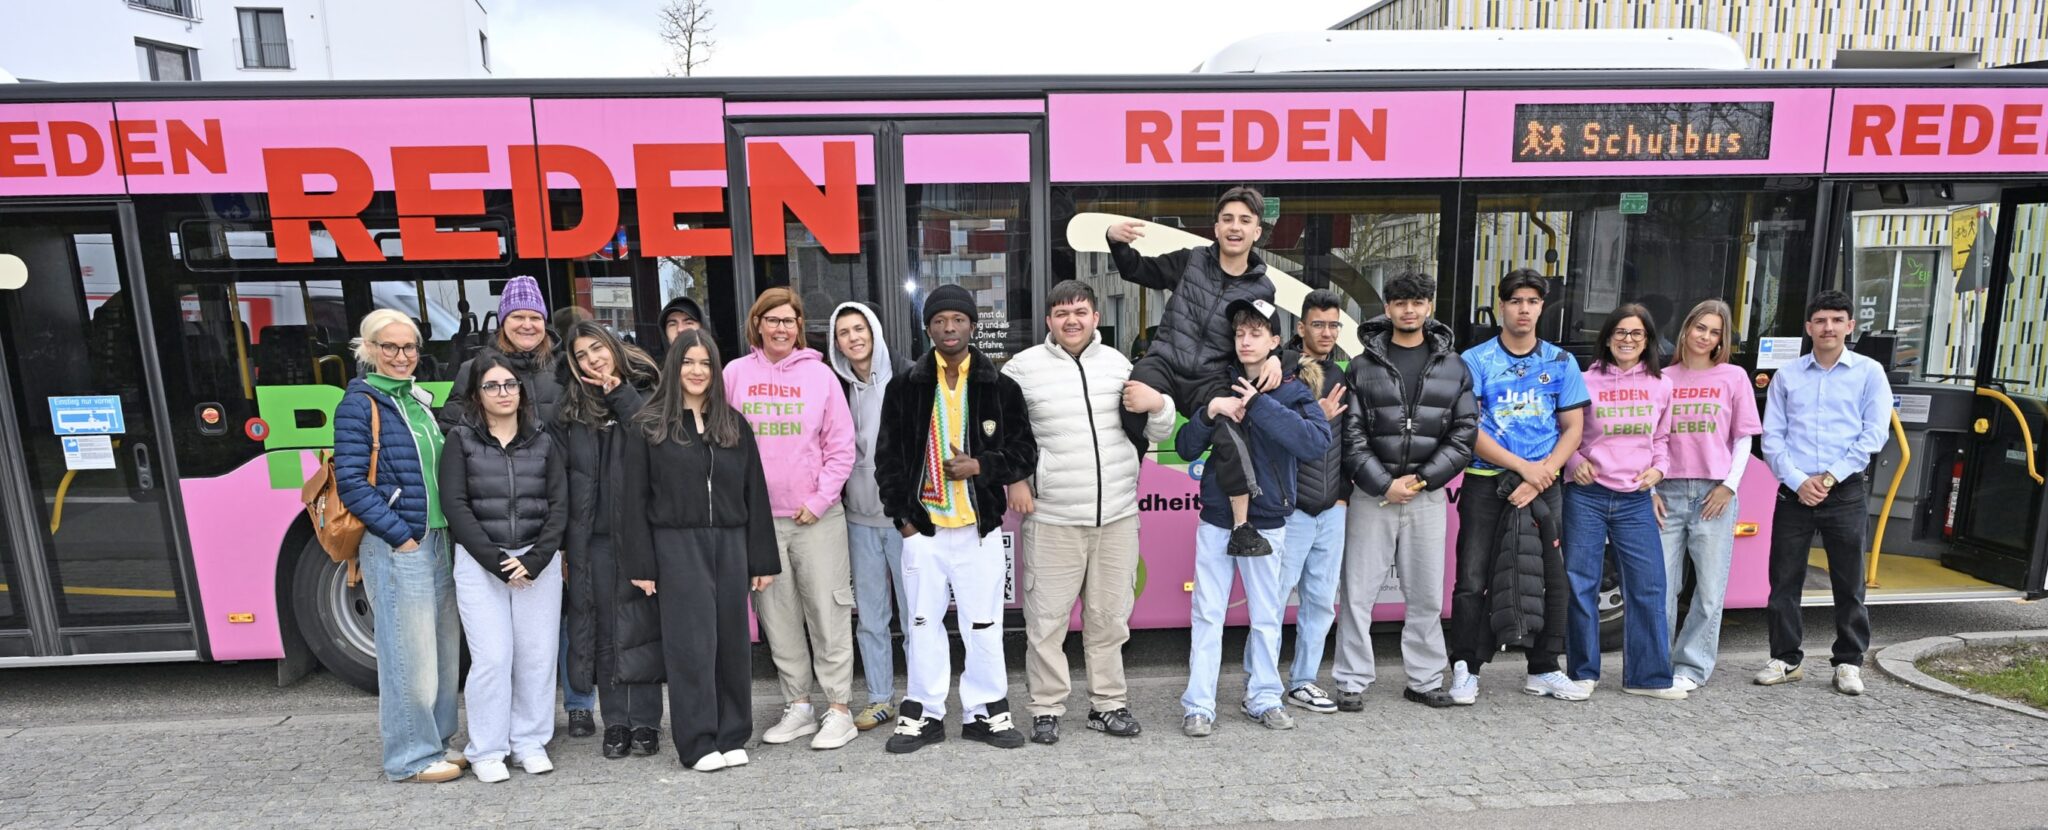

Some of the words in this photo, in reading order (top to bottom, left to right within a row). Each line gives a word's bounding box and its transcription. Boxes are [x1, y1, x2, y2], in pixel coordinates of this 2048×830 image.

[1125, 108, 1388, 164] REDEN
[1848, 104, 2048, 156] REDE
[1582, 122, 1742, 155] Schulbus
[262, 141, 861, 263] REDEN
[985, 320, 999, 329] und
[997, 330, 1008, 338] for
[978, 340, 1005, 349] Erfahre,
[748, 383, 802, 398] REDEN
[1599, 388, 1649, 402] REDEN
[742, 402, 805, 416] RETTET
[1596, 404, 1654, 418] RETTET
[1603, 422, 1653, 436] LEBEN
